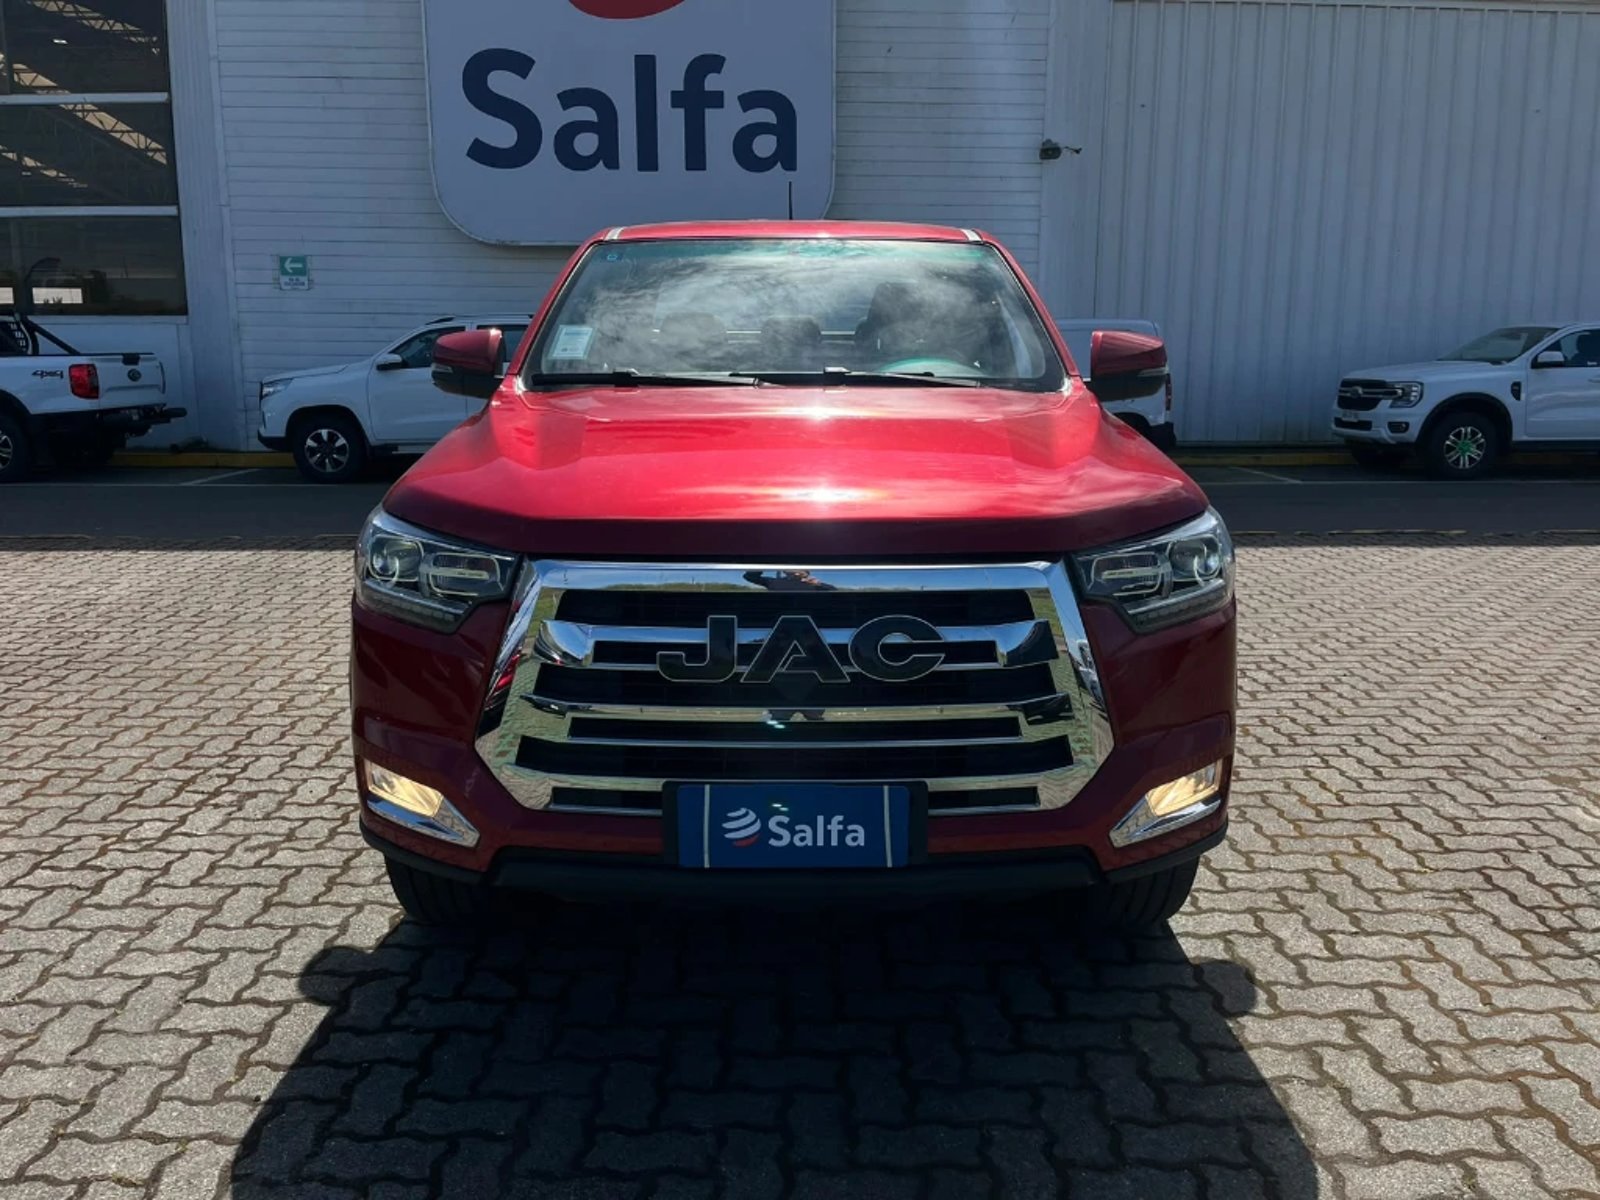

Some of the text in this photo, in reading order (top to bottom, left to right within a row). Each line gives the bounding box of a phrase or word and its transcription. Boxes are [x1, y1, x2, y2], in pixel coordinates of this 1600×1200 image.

[462, 47, 798, 173] Salfa
[656, 614, 946, 683] JAC
[768, 815, 865, 847] Salfa
